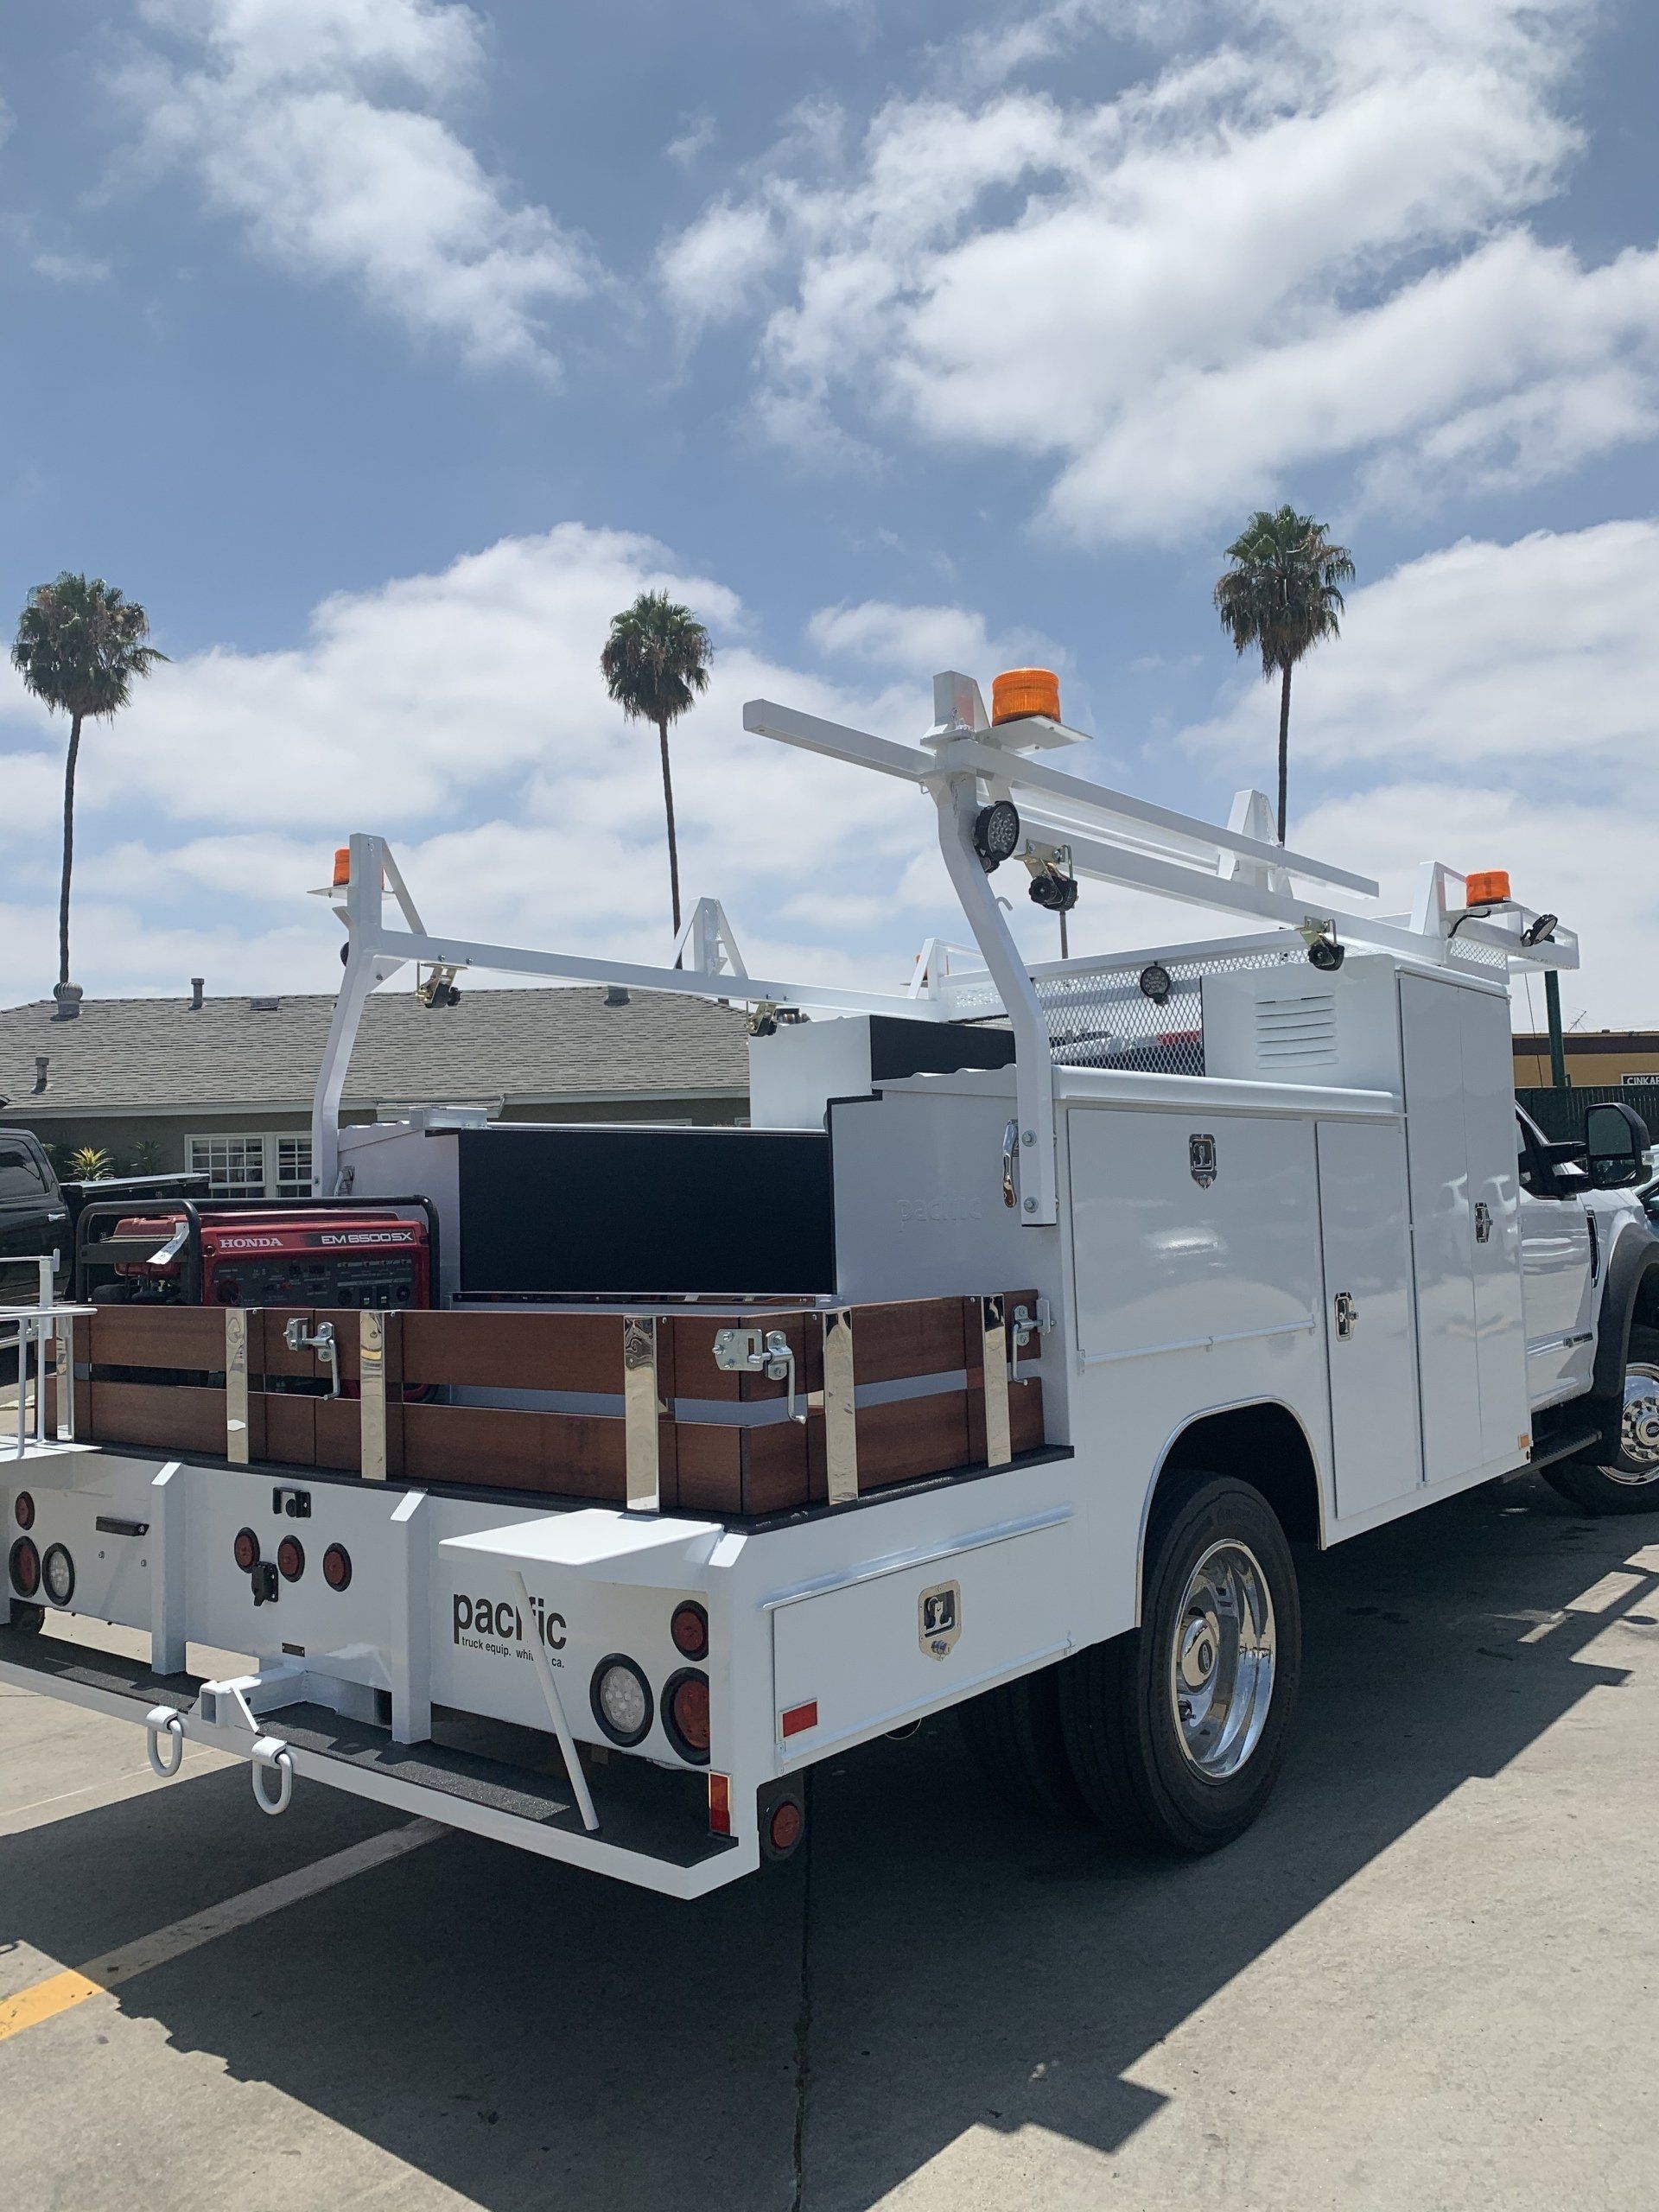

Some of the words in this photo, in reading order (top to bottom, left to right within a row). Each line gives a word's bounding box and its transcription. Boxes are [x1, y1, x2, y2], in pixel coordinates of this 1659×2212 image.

[219, 1237, 283, 1249] HONDA
[461, 1637, 484, 1649] truck
[486, 1643, 512, 1657] equip.
[551, 1657, 564, 1668] ca.
